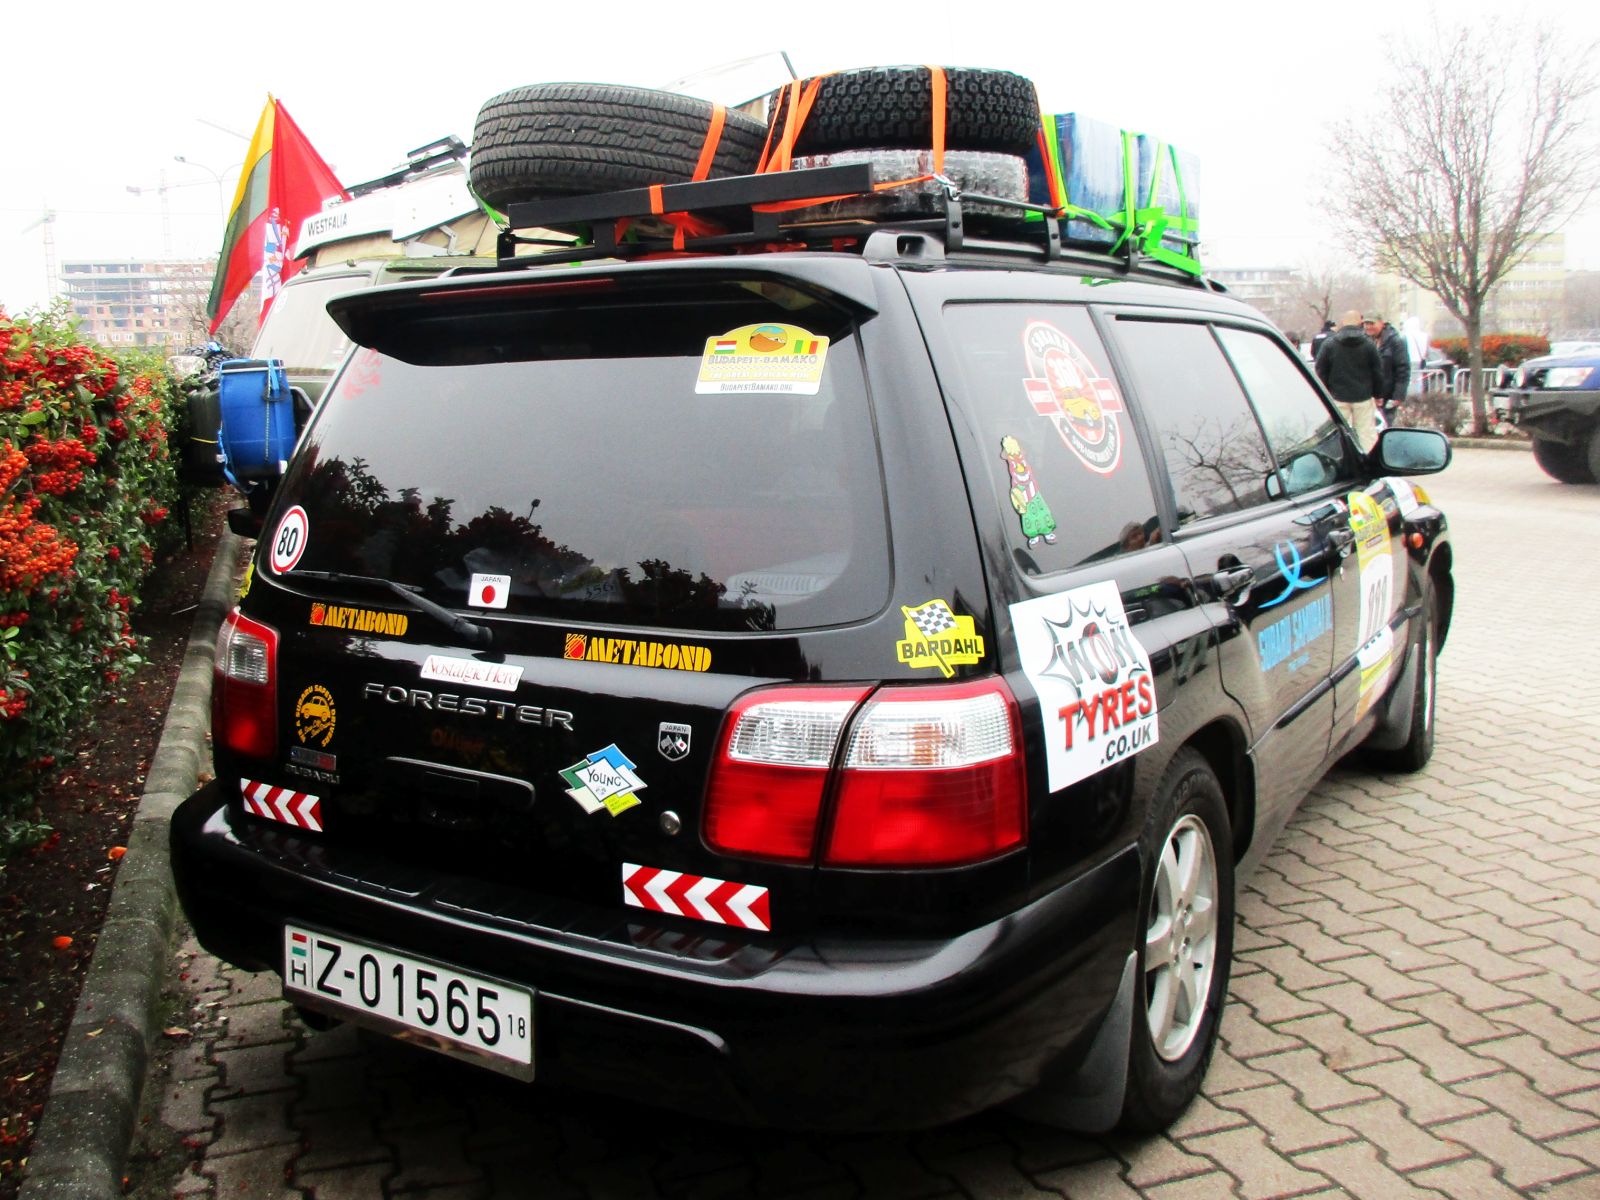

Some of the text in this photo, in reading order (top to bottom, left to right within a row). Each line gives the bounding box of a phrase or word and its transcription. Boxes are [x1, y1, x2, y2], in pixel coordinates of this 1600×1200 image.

[307, 213, 348, 237] WESTFALIA
[277, 527, 299, 557] 80
[324, 605, 408, 636] METABOND
[586, 637, 712, 672] METABOND
[901, 639, 982, 659] BARDAHL
[1056, 621, 1138, 685] WOW
[485, 664, 519, 686] Hero
[364, 682, 574, 732] FORESTER
[1058, 674, 1153, 753] TYRES
[665, 725, 687, 733] JAPAN
[1101, 723, 1152, 765] .CO.UK
[587, 768, 622, 787] YOUNG
[291, 940, 526, 1047] H Z-01565 18
